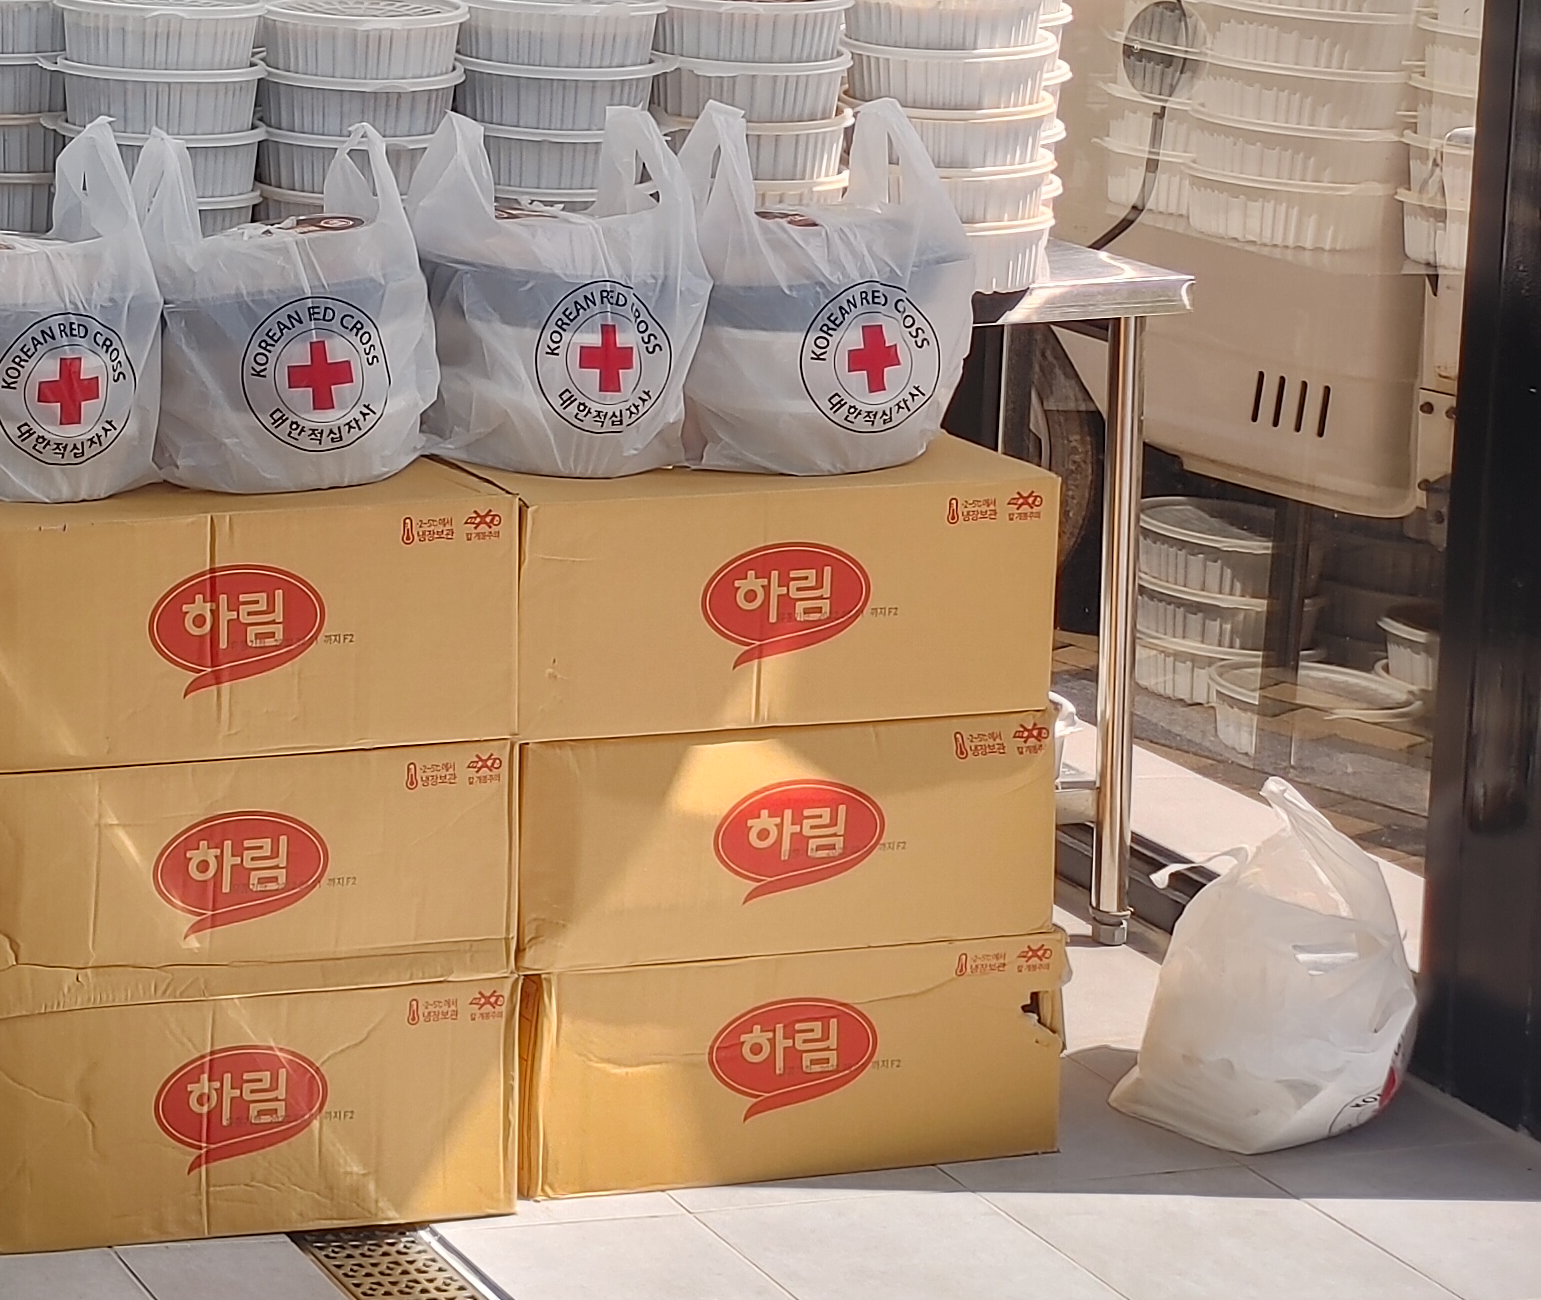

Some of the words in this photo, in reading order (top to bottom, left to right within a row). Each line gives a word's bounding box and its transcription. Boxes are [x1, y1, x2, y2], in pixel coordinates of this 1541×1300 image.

[251, 310, 304, 378] KOREAN
[340, 314, 379, 366] CROSS
[545, 291, 597, 356] KOREAN
[810, 294, 858, 361] KOREAN
[1, 326, 56, 390] KOREAN
[58, 322, 88, 339] RED
[93, 331, 126, 383] CROSS
[269, 403, 377, 445] 대한적십자사
[558, 388, 652, 428] 대한적십자사
[827, 384, 926, 427] 대한적십자사
[17, 419, 118, 459] 대한적십자사
[417, 529, 454, 541] 냉장보관
[962, 509, 997, 521] 냉장보관
[182, 589, 284, 649] 하림
[733, 566, 834, 623] 하림
[420, 774, 457, 786] 냉장보관
[747, 805, 847, 861] 하림
[185, 835, 288, 894] 하림
[739, 1017, 839, 1075] 하림
[186, 1067, 288, 1127] 하림
